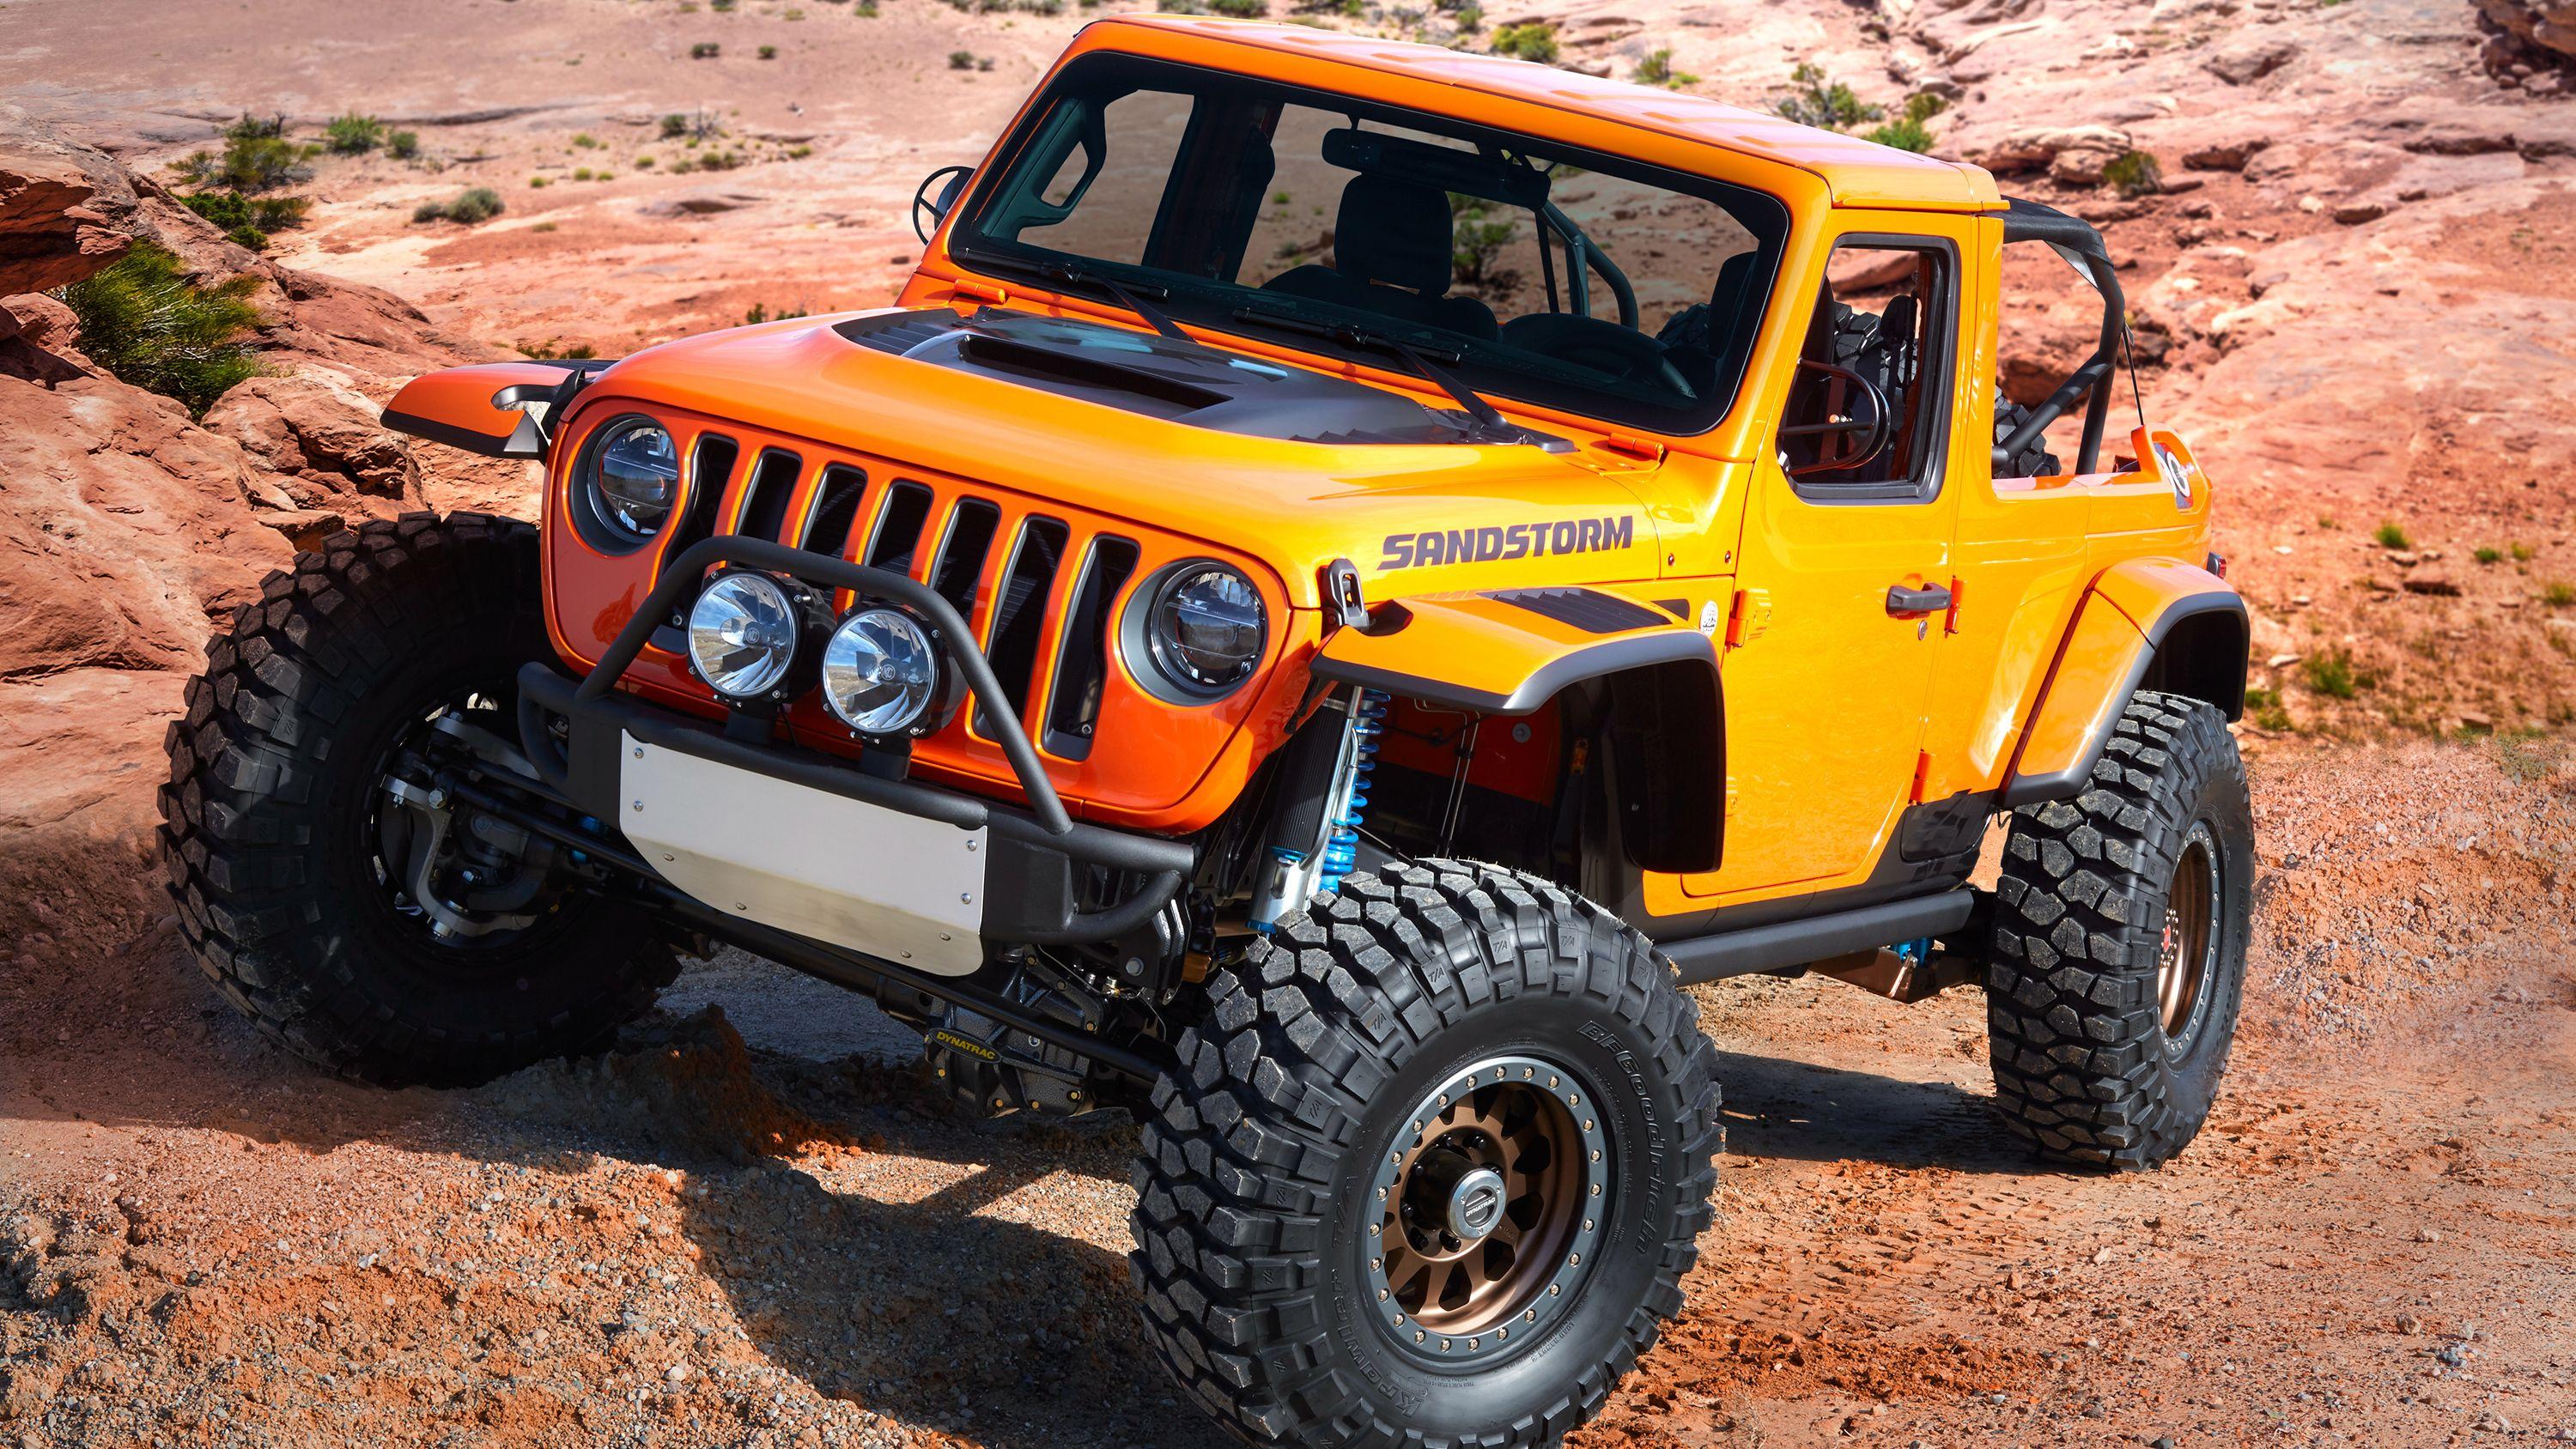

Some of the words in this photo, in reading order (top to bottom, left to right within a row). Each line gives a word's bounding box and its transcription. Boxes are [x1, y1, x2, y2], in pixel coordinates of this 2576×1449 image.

[1376, 515, 1633, 570] SANDSTORM
[1492, 941, 1509, 955] T/A
[1560, 935, 1576, 948] T/A
[1428, 966, 1445, 983] T/A
[937, 1032, 995, 1059] DYNATRAC
[1577, 1020, 1665, 1256] BFGoodrich
[1465, 1197, 1496, 1217] DYNATRAC
